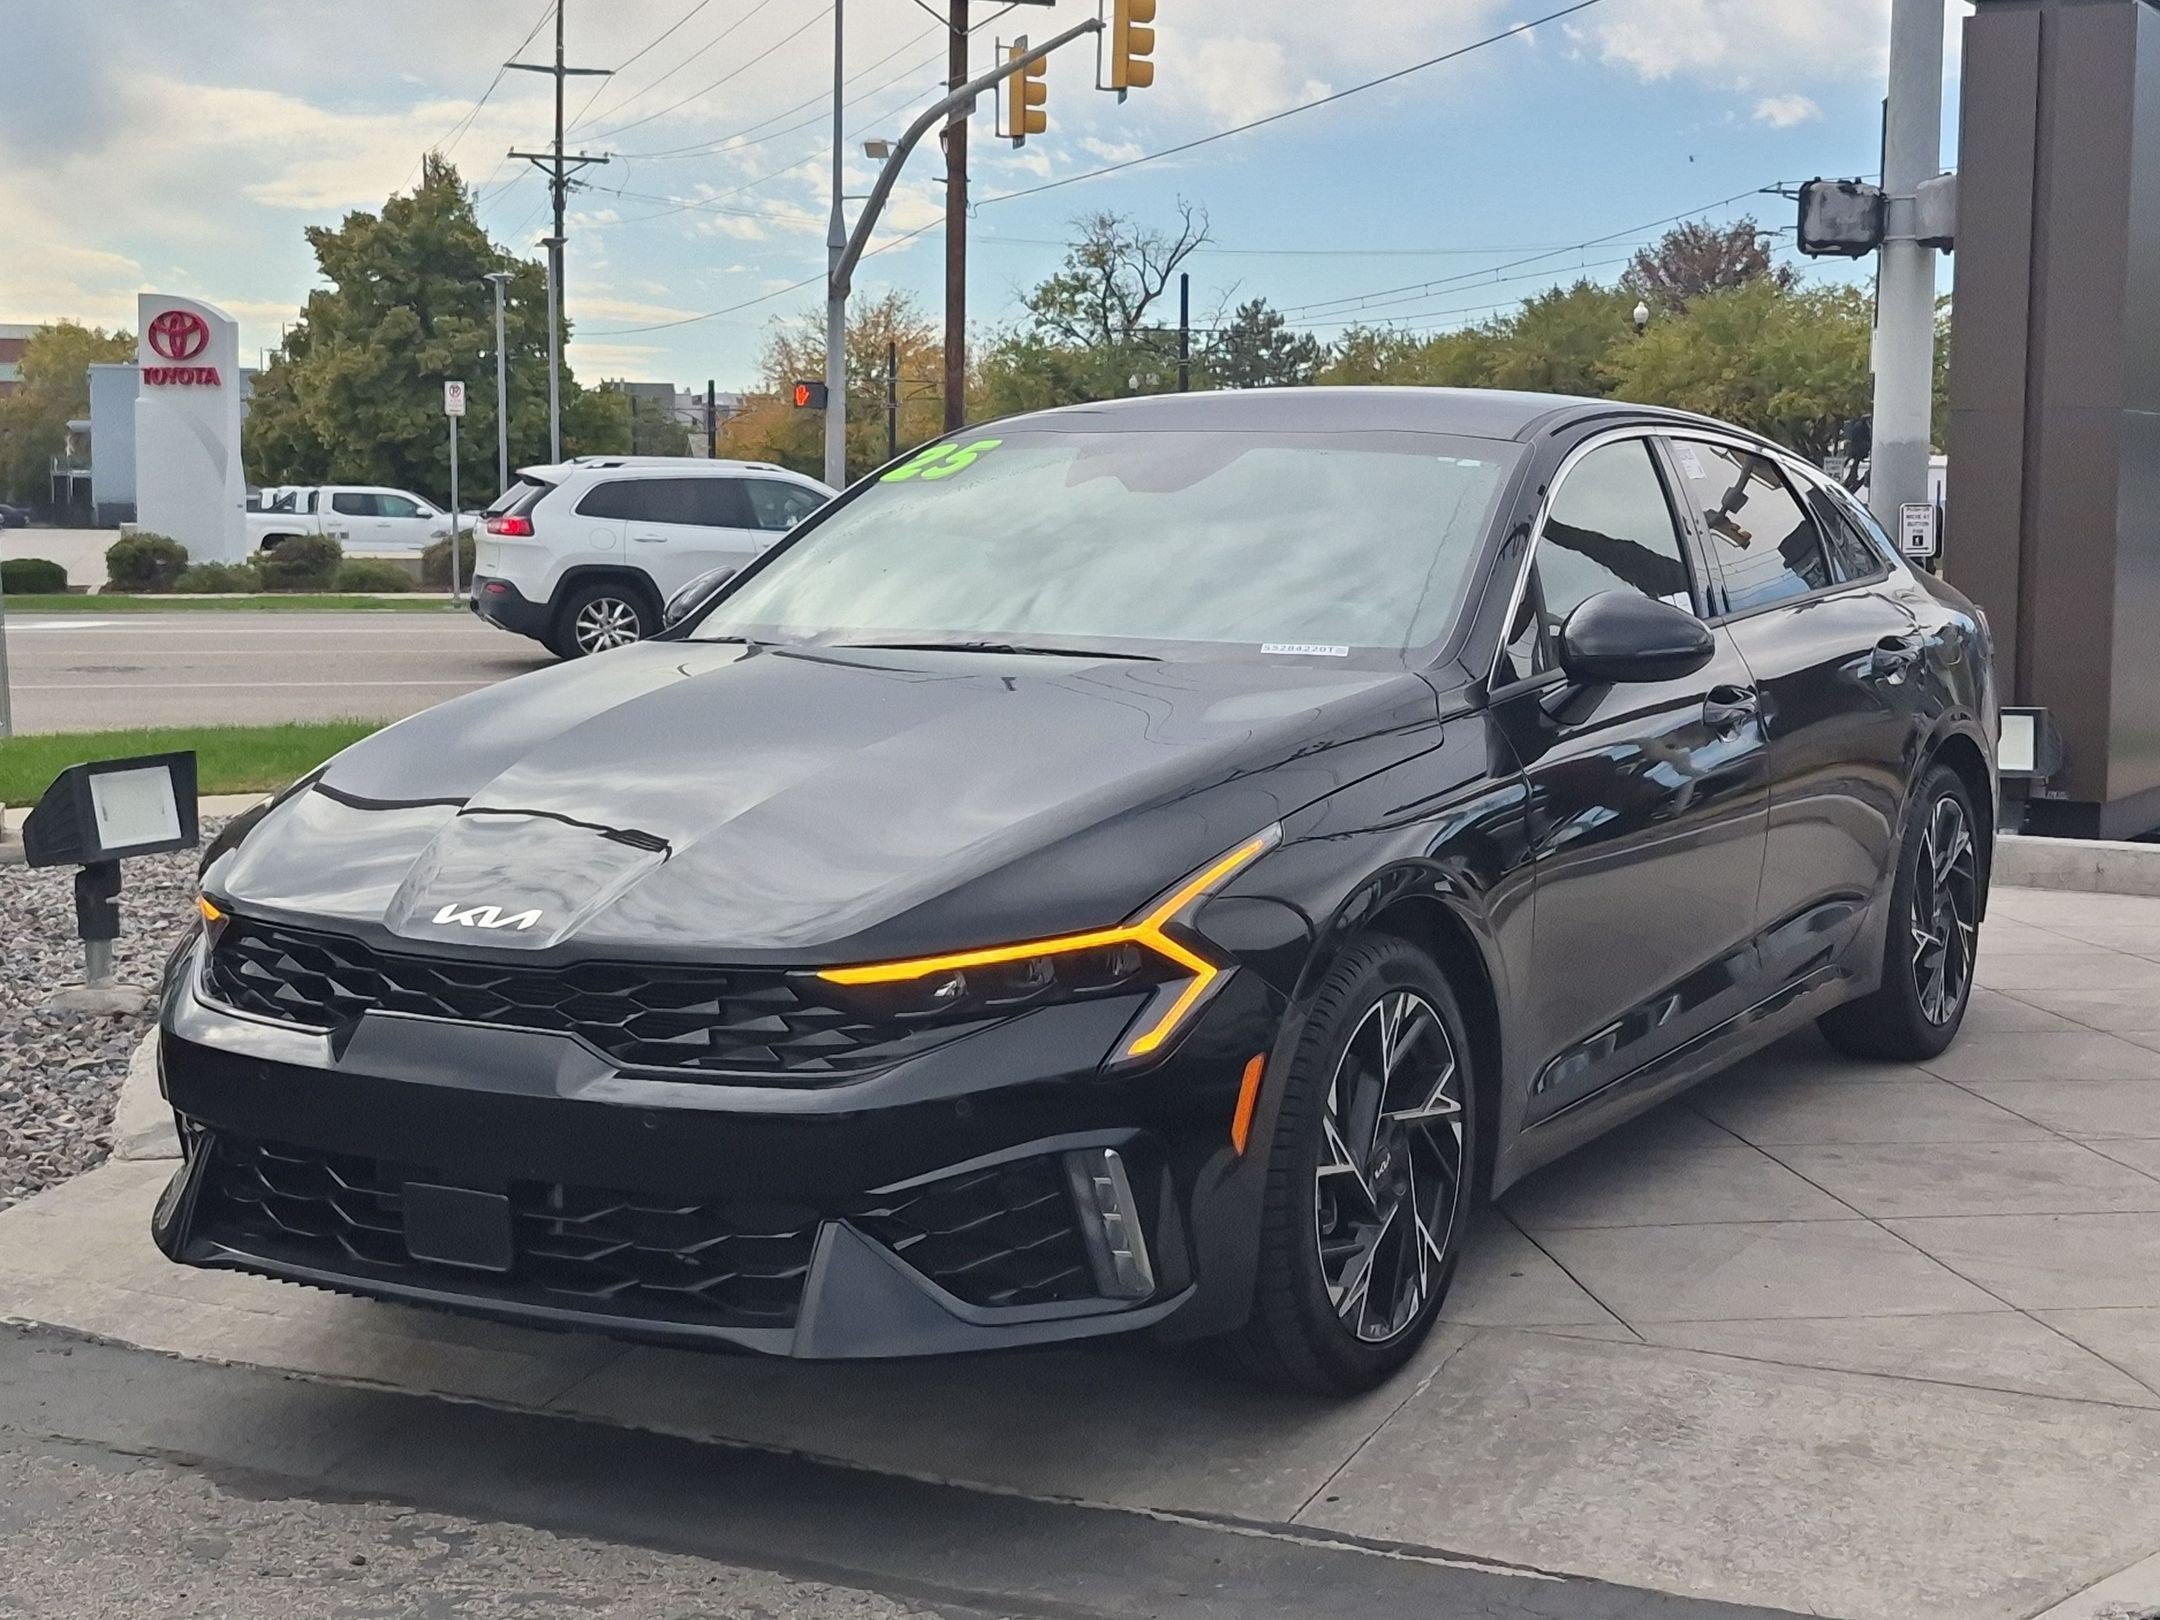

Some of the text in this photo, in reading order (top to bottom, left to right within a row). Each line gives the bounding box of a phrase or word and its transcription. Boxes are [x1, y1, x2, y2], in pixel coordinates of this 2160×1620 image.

[141, 366, 221, 386] TOYOTA
[879, 438, 1003, 483] 25
[431, 903, 544, 930] KIA
